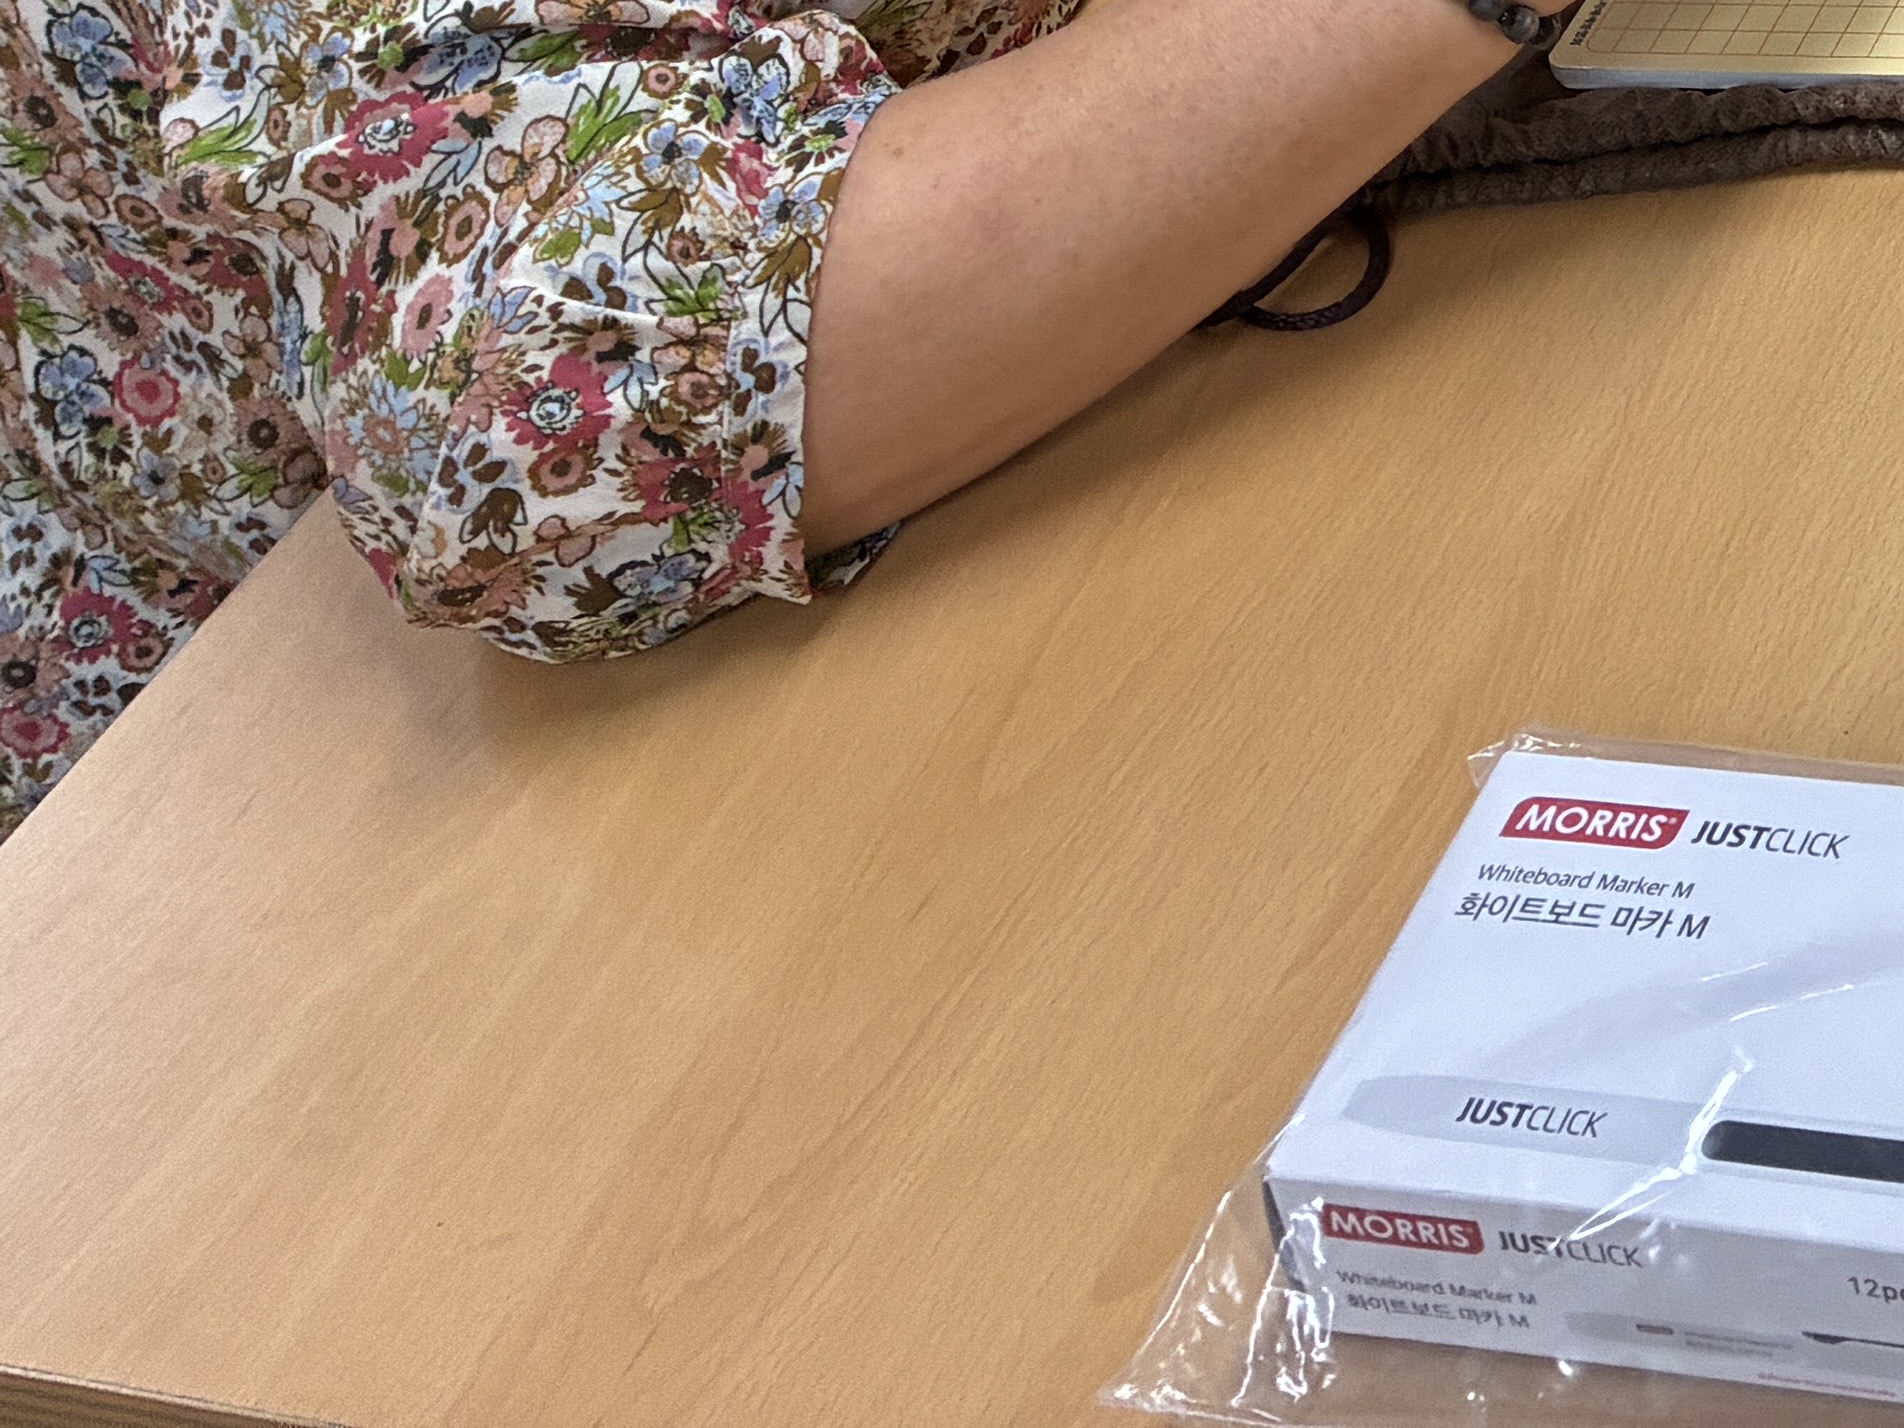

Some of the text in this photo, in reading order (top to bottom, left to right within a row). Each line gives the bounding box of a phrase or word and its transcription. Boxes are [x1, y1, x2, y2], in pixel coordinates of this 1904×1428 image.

[1690, 820, 1851, 860] JUSTCLICK
[1477, 863, 1696, 900] Whiteboard Marker M
[1453, 891, 1712, 940] 화이트보드 마카 M
[1455, 1096, 1609, 1138] JUSTCLICK
[1336, 1270, 1538, 1306] Whiteboard Marker M
[1347, 1293, 1530, 1329] 화이트보드 마카 M
